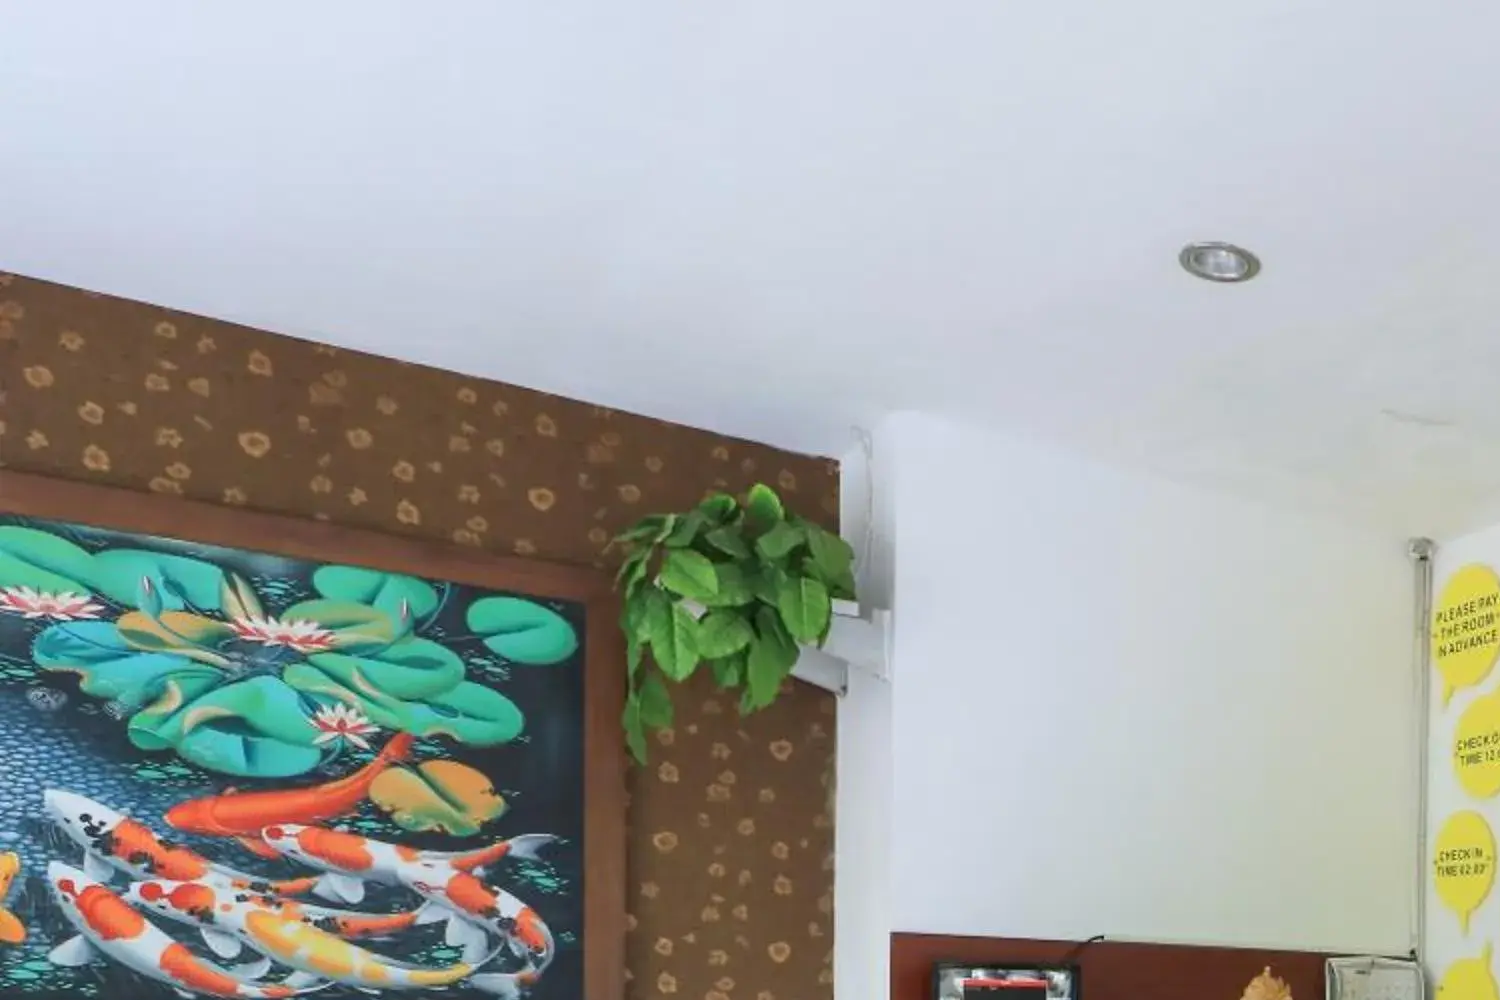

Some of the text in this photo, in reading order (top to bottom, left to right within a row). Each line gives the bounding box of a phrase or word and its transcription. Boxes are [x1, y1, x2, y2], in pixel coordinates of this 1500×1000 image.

[1435, 601, 1477, 623] PLEASE
[1441, 612, 1495, 641] THE ROOM
[1448, 629, 1497, 654] ADVANCE
[1457, 734, 1491, 751] CHECK
[1439, 849, 1471, 862] CHECK
